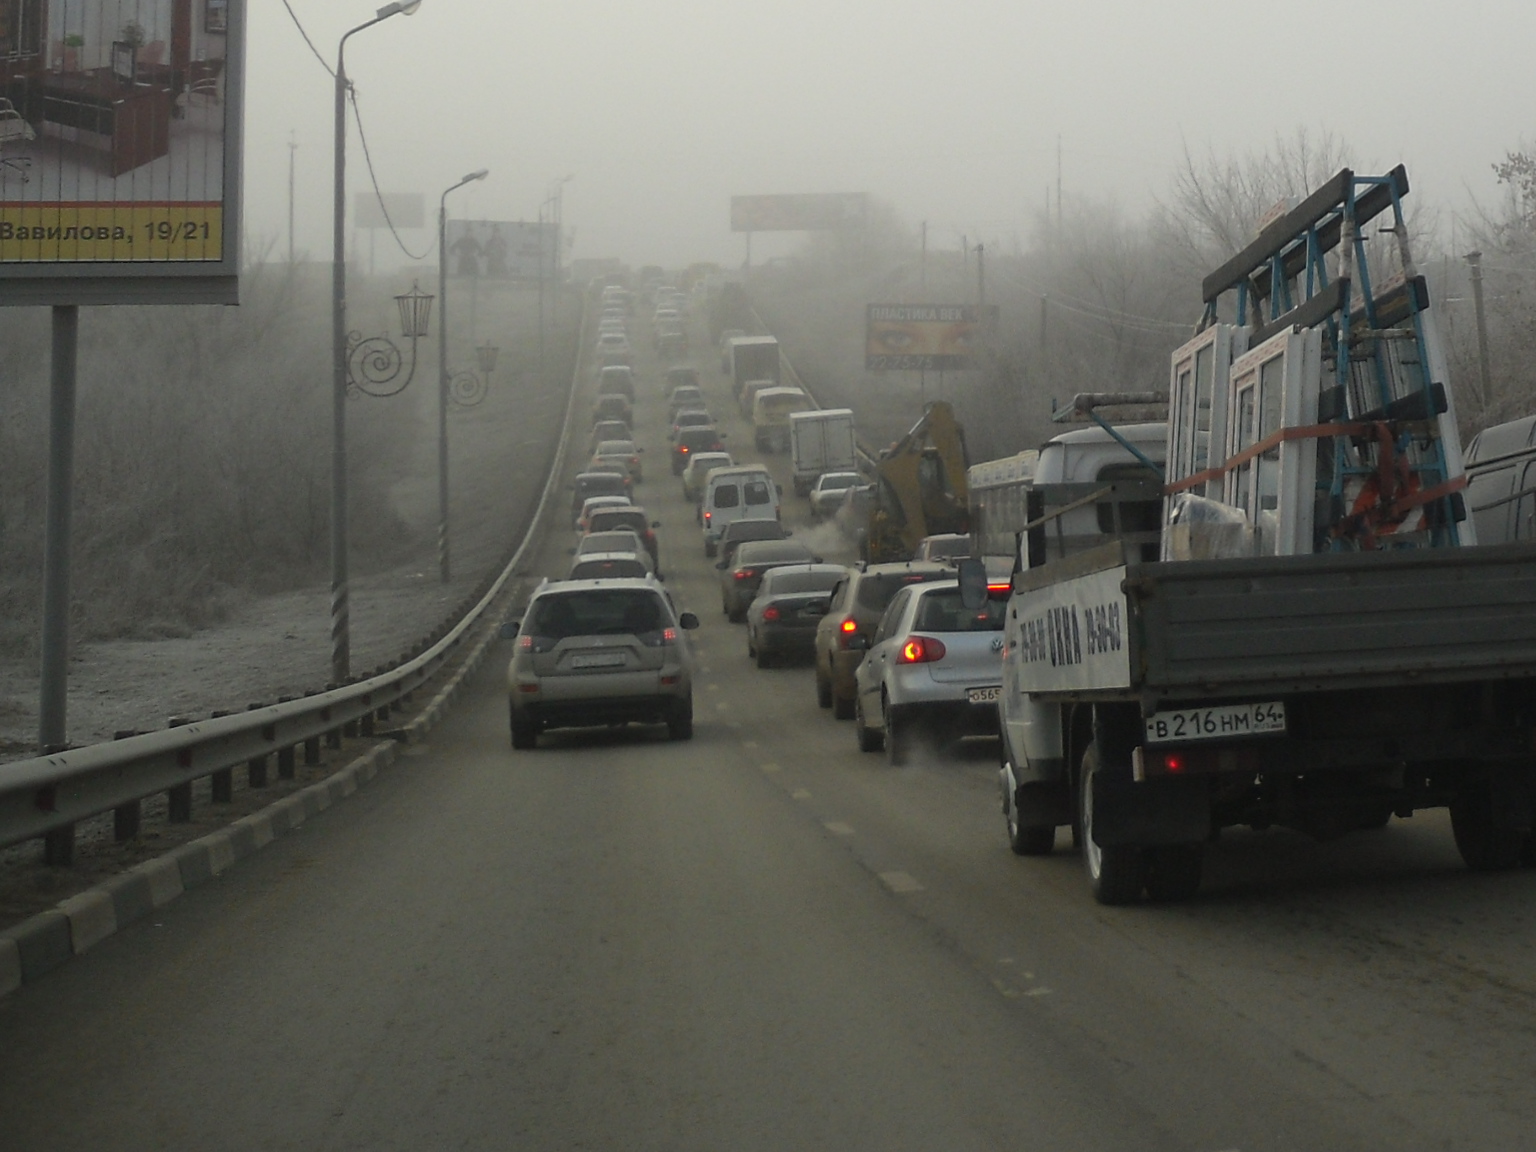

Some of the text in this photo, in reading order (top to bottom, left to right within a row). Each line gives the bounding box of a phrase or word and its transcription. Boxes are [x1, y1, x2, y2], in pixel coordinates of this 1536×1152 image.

[0, 220, 210, 244] Вавилова, 19/21
[1047, 603, 1082, 667] ОКНА
